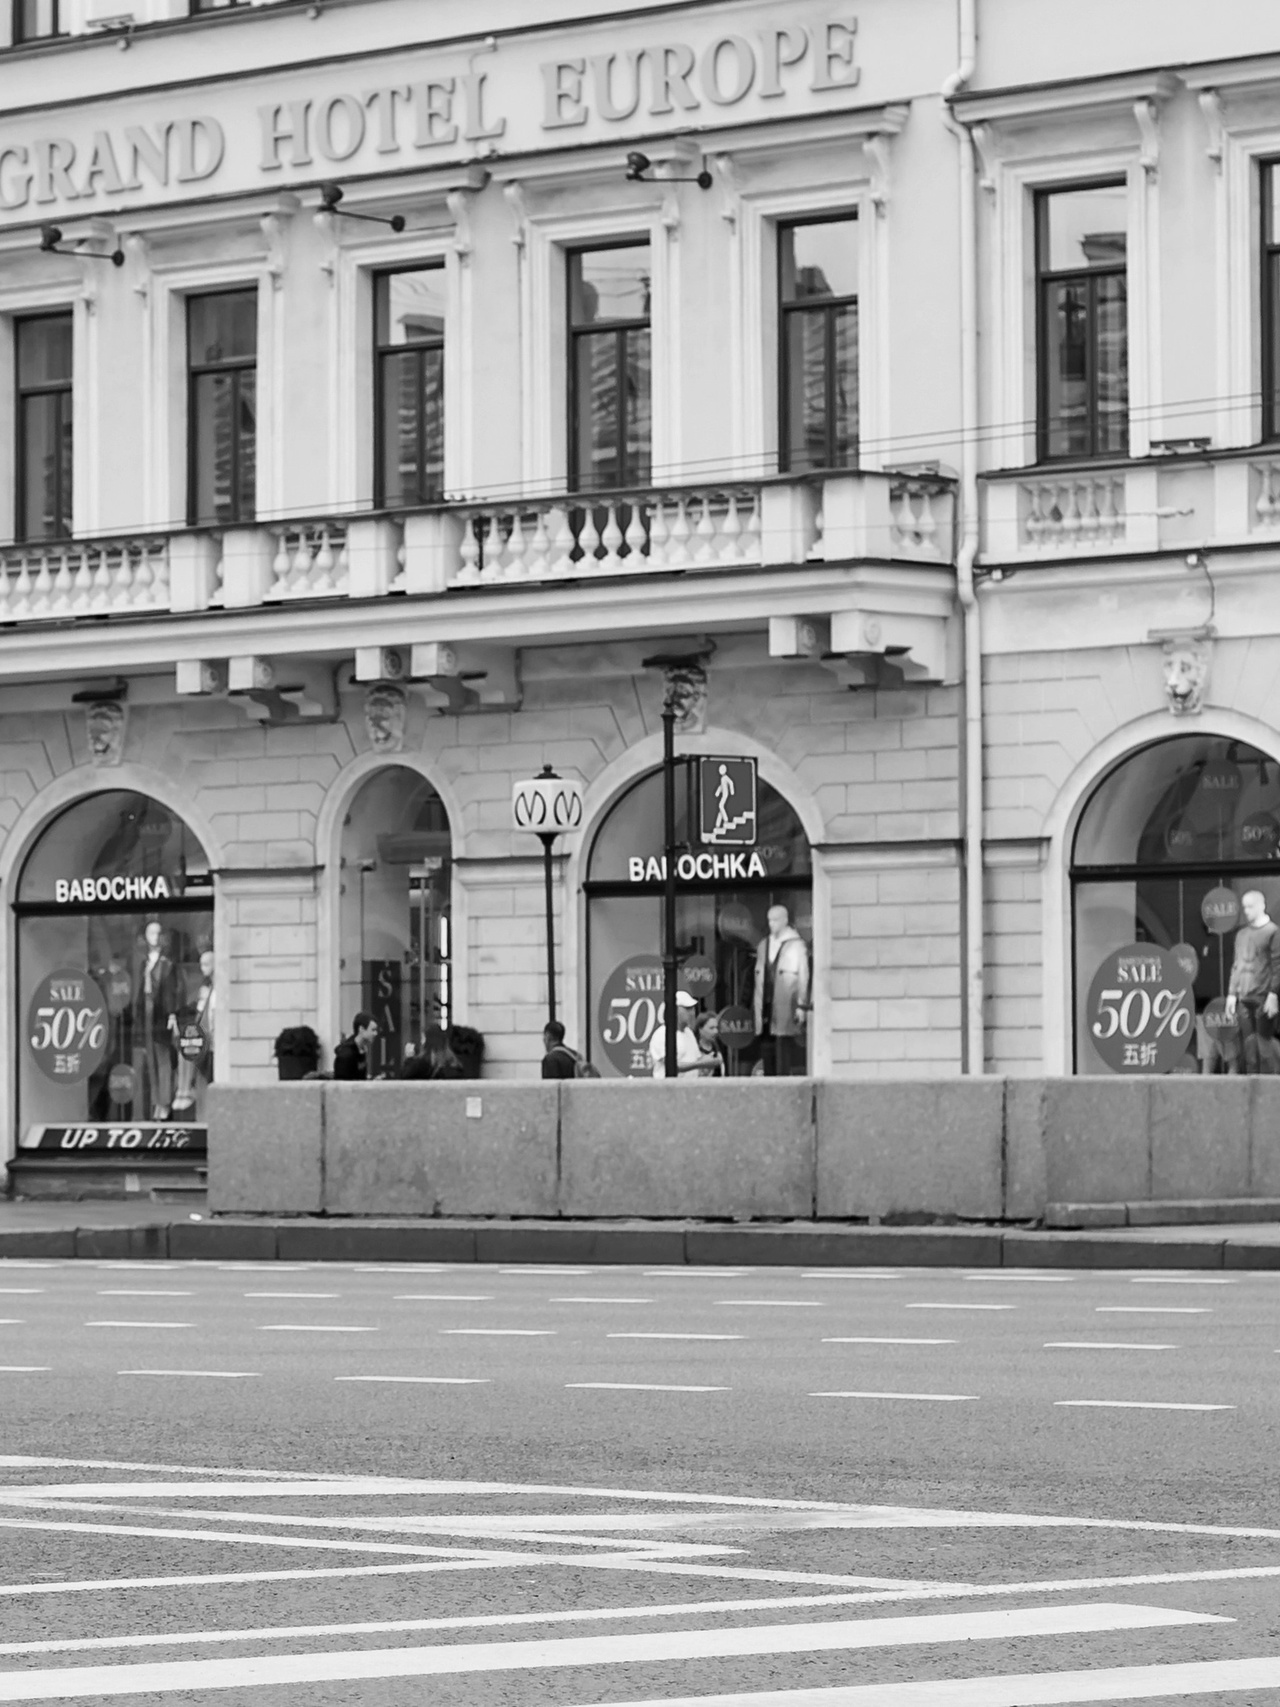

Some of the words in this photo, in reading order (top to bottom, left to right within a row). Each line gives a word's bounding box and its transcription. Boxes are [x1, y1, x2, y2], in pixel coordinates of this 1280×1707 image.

[257, 72, 507, 171] HOTEL
[539, 16, 862, 131] EUROPE
[55, 875, 170, 903] BABOCHKA
[1117, 963, 1163, 984] SALE
[30, 1006, 106, 1050] 50%
[1092, 986, 1191, 1040] 50%
[61, 1128, 99, 1149] UP
[107, 1128, 142, 1149] TO
